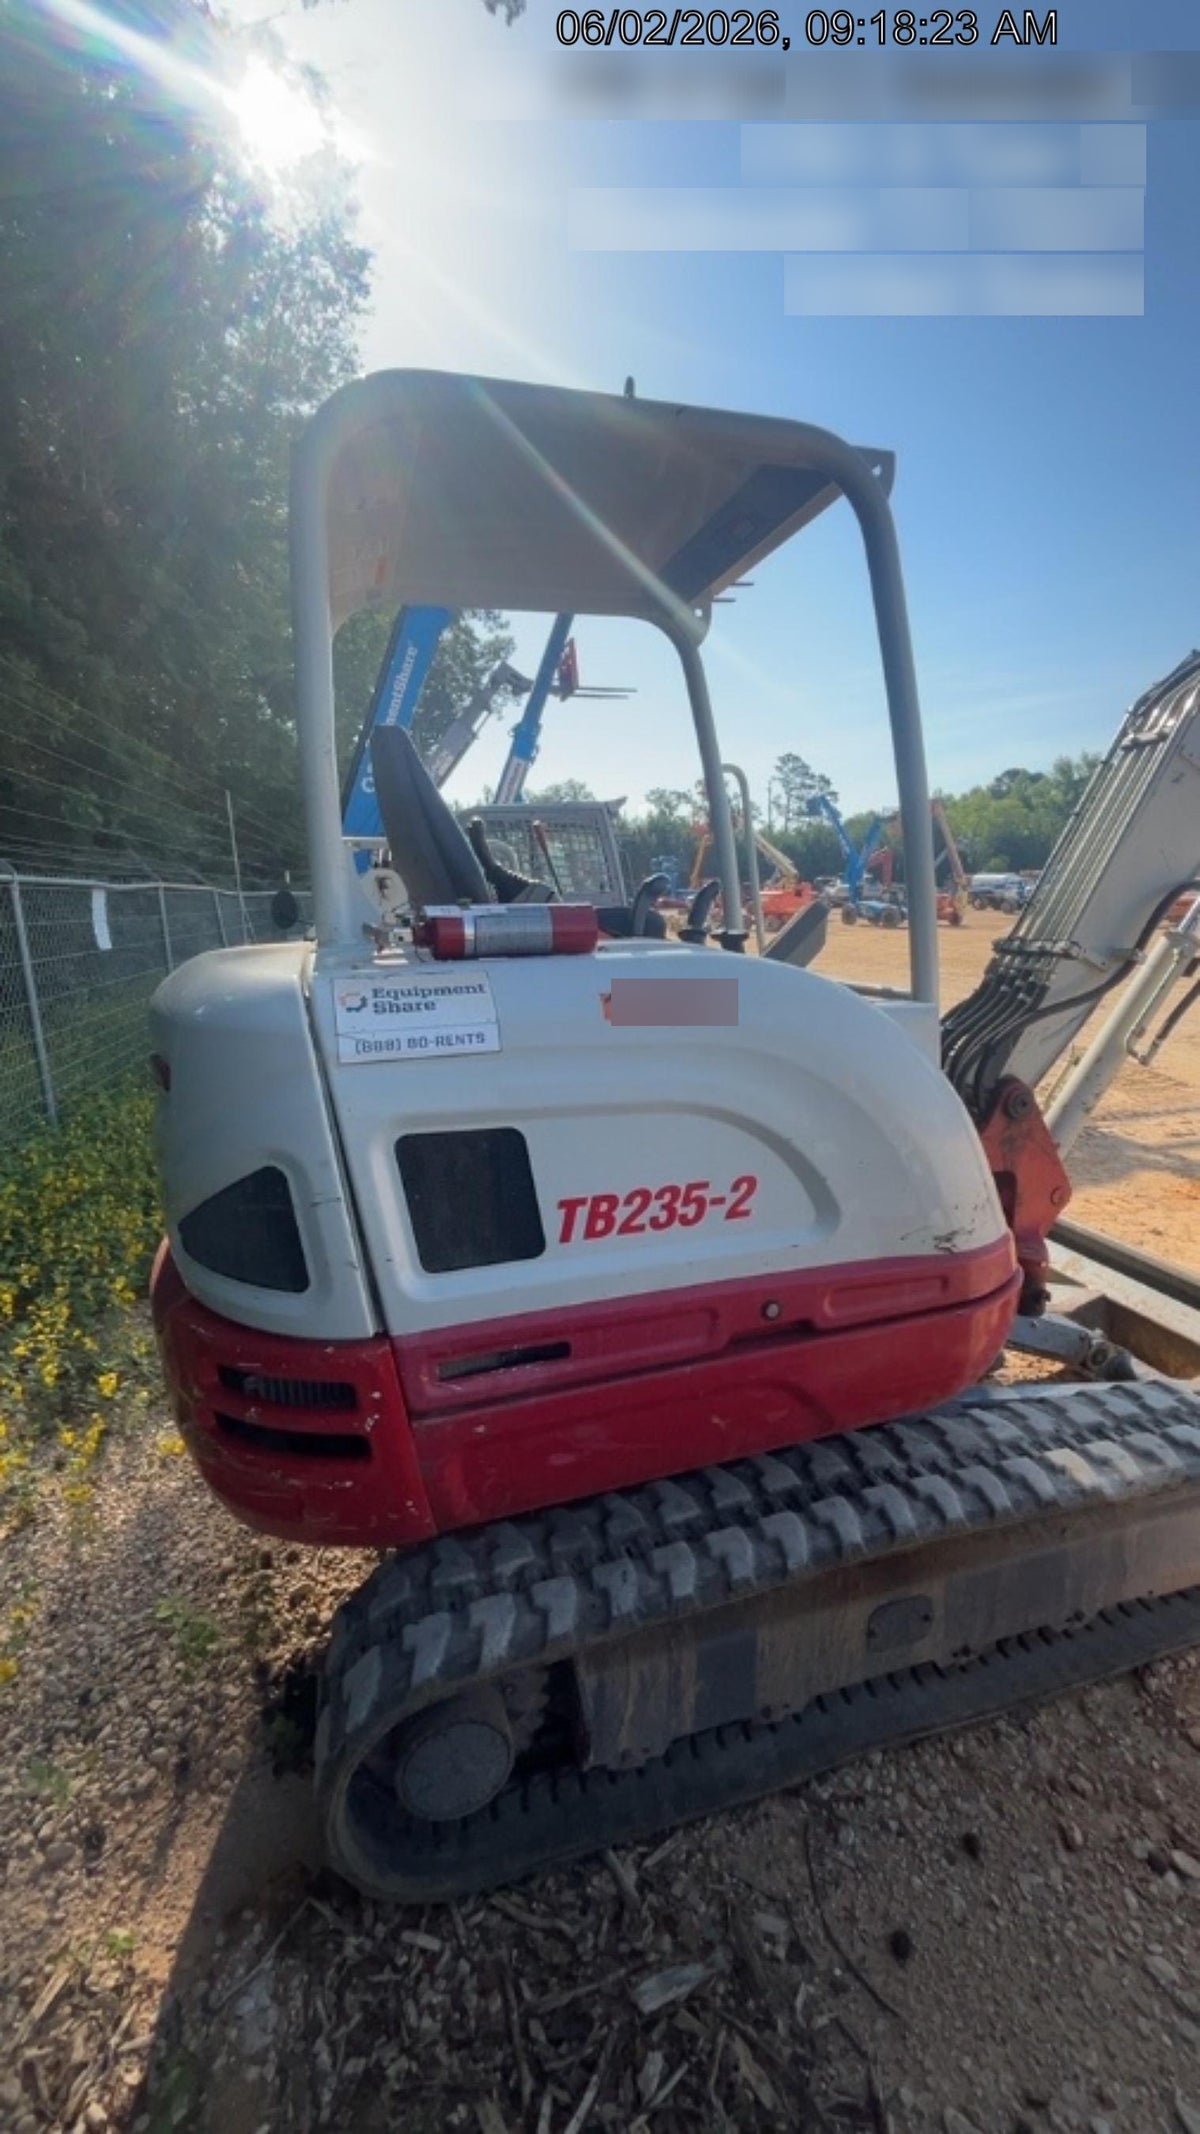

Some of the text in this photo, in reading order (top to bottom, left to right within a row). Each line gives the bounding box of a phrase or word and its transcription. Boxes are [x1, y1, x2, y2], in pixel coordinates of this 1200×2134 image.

[371, 983, 487, 1001] Equipment
[372, 1000, 437, 1015] Share
[557, 1175, 758, 1244] TB235-2
